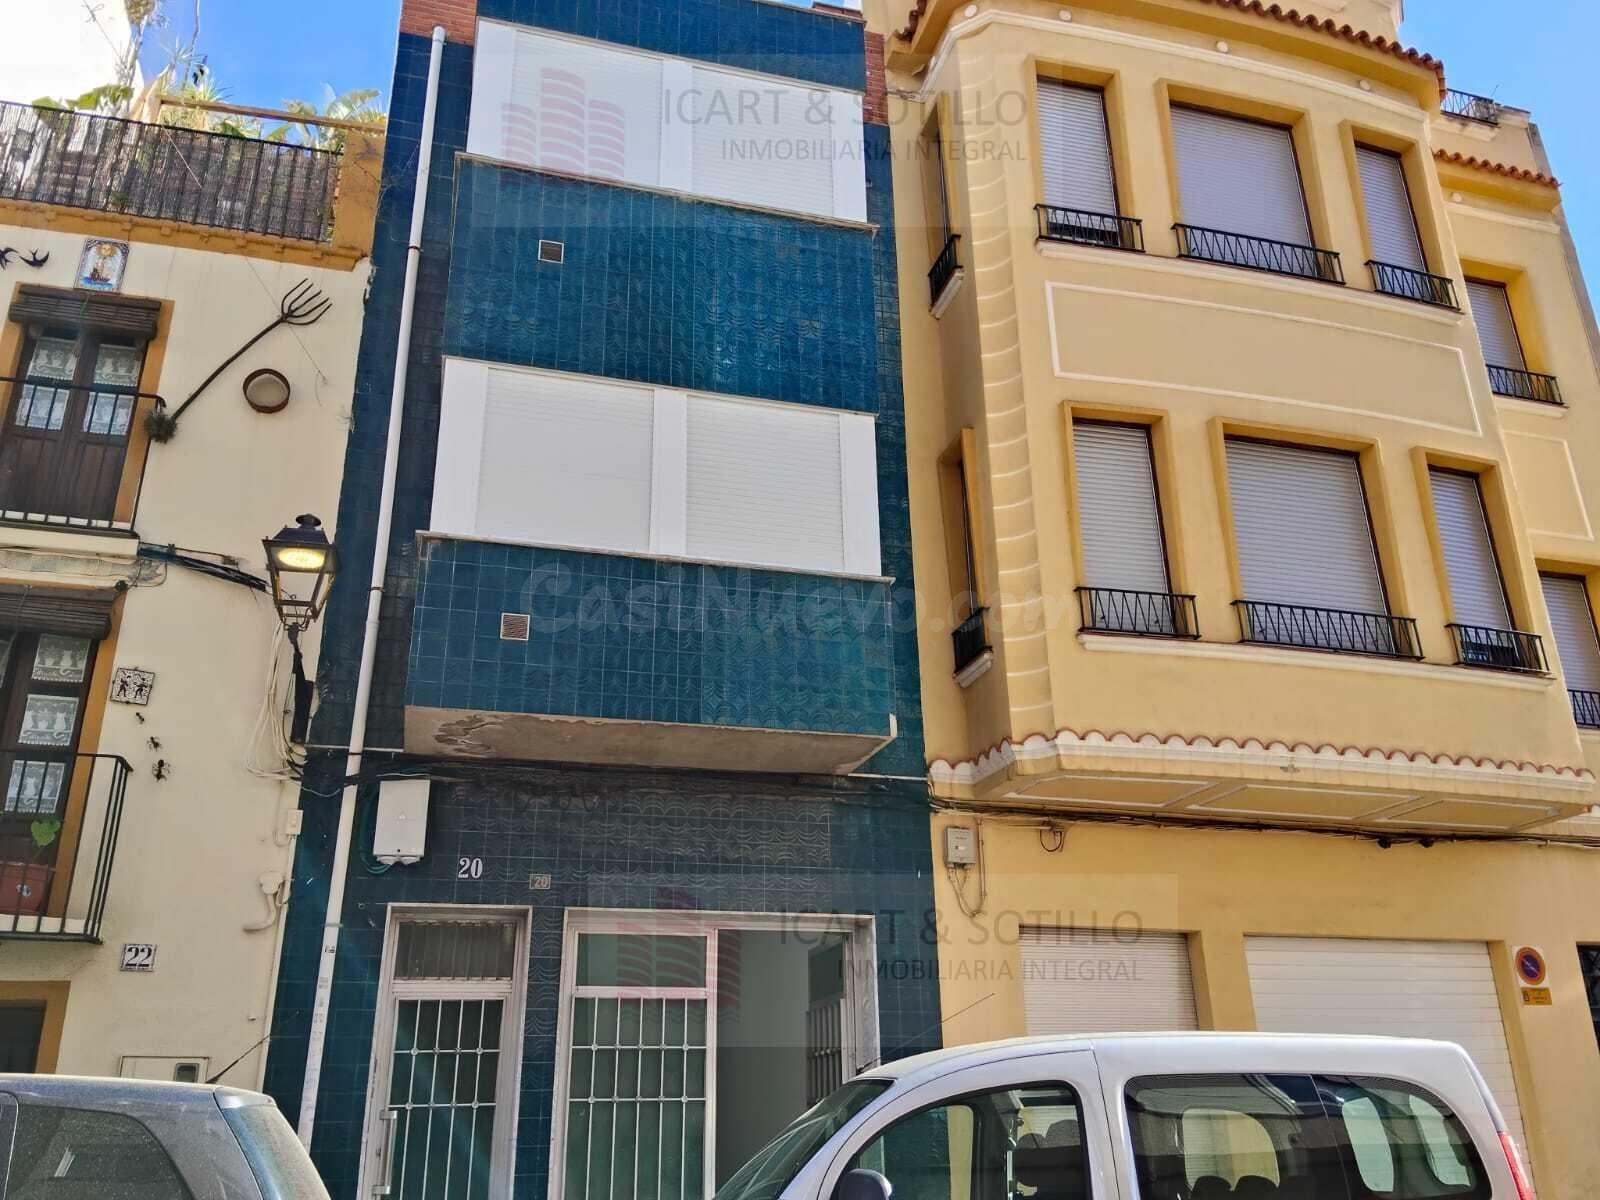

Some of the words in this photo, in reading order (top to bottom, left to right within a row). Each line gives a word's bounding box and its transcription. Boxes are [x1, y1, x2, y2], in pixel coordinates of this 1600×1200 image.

[458, 857, 483, 879] 20
[534, 875, 549, 888] 20
[125, 946, 153, 967] 22
